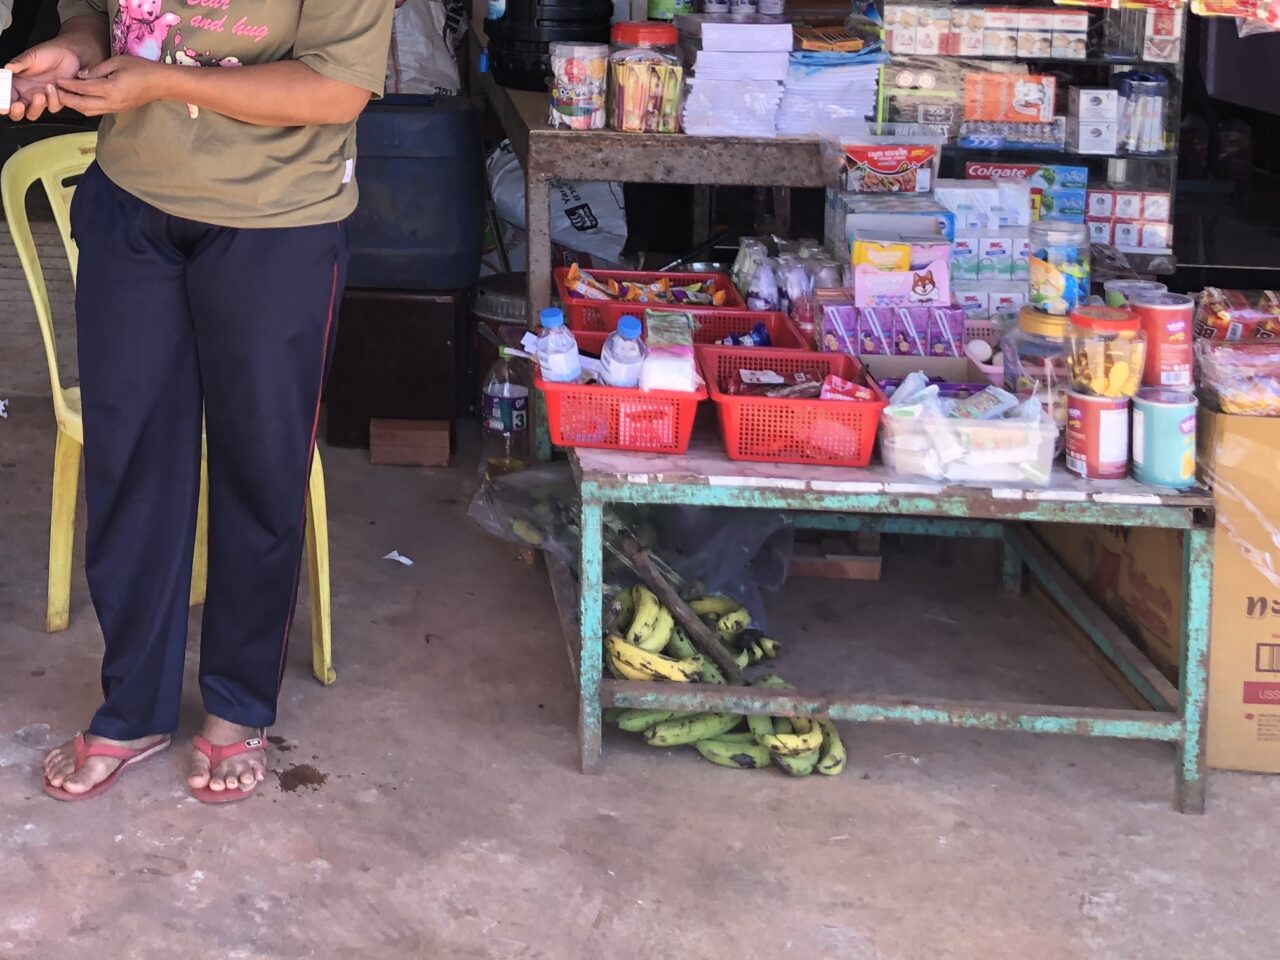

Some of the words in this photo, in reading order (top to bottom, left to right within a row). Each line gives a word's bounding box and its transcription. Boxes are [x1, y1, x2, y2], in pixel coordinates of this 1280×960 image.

[190, 15, 224, 33] and
[231, 16, 269, 42] hug
[968, 164, 1026, 178] Colgate
